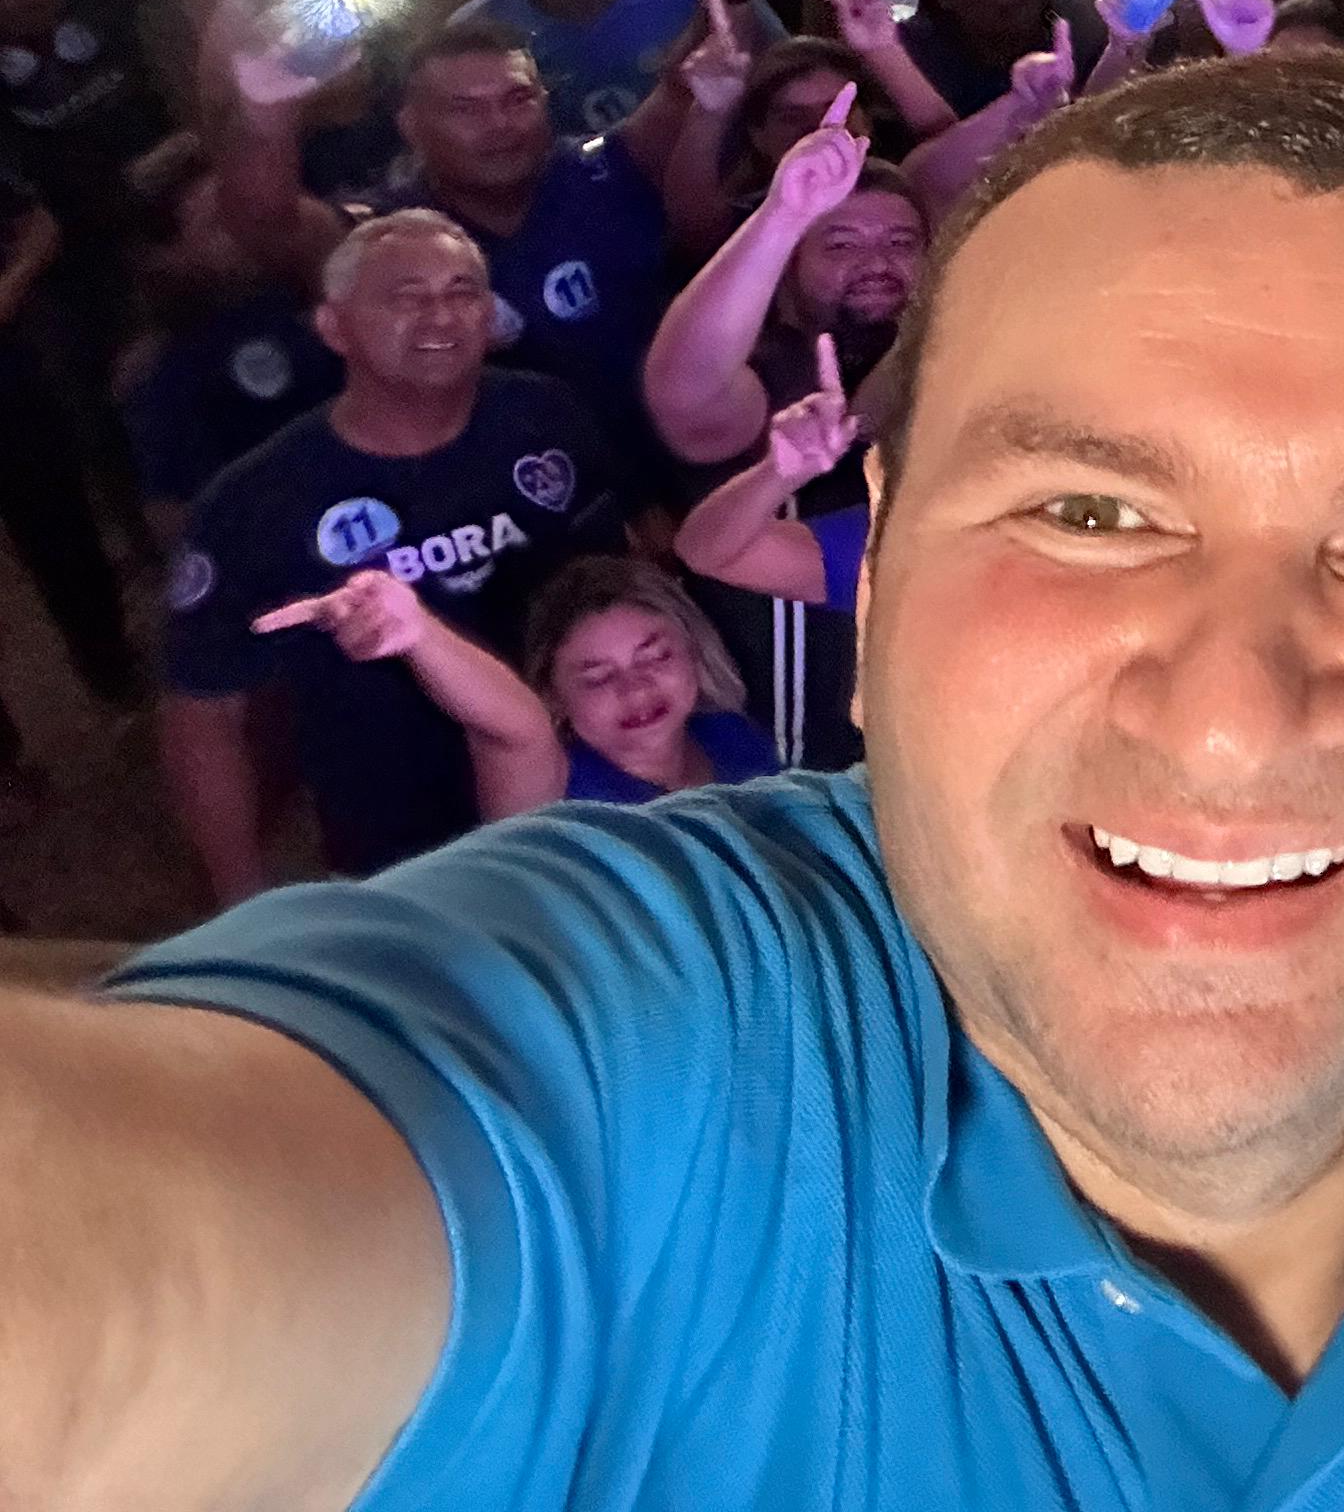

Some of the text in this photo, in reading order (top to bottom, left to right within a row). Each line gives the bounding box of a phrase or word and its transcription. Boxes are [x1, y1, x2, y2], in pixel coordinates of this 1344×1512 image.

[555, 268, 593, 308] 11
[331, 505, 378, 553] 11
[386, 512, 528, 582] BORA
